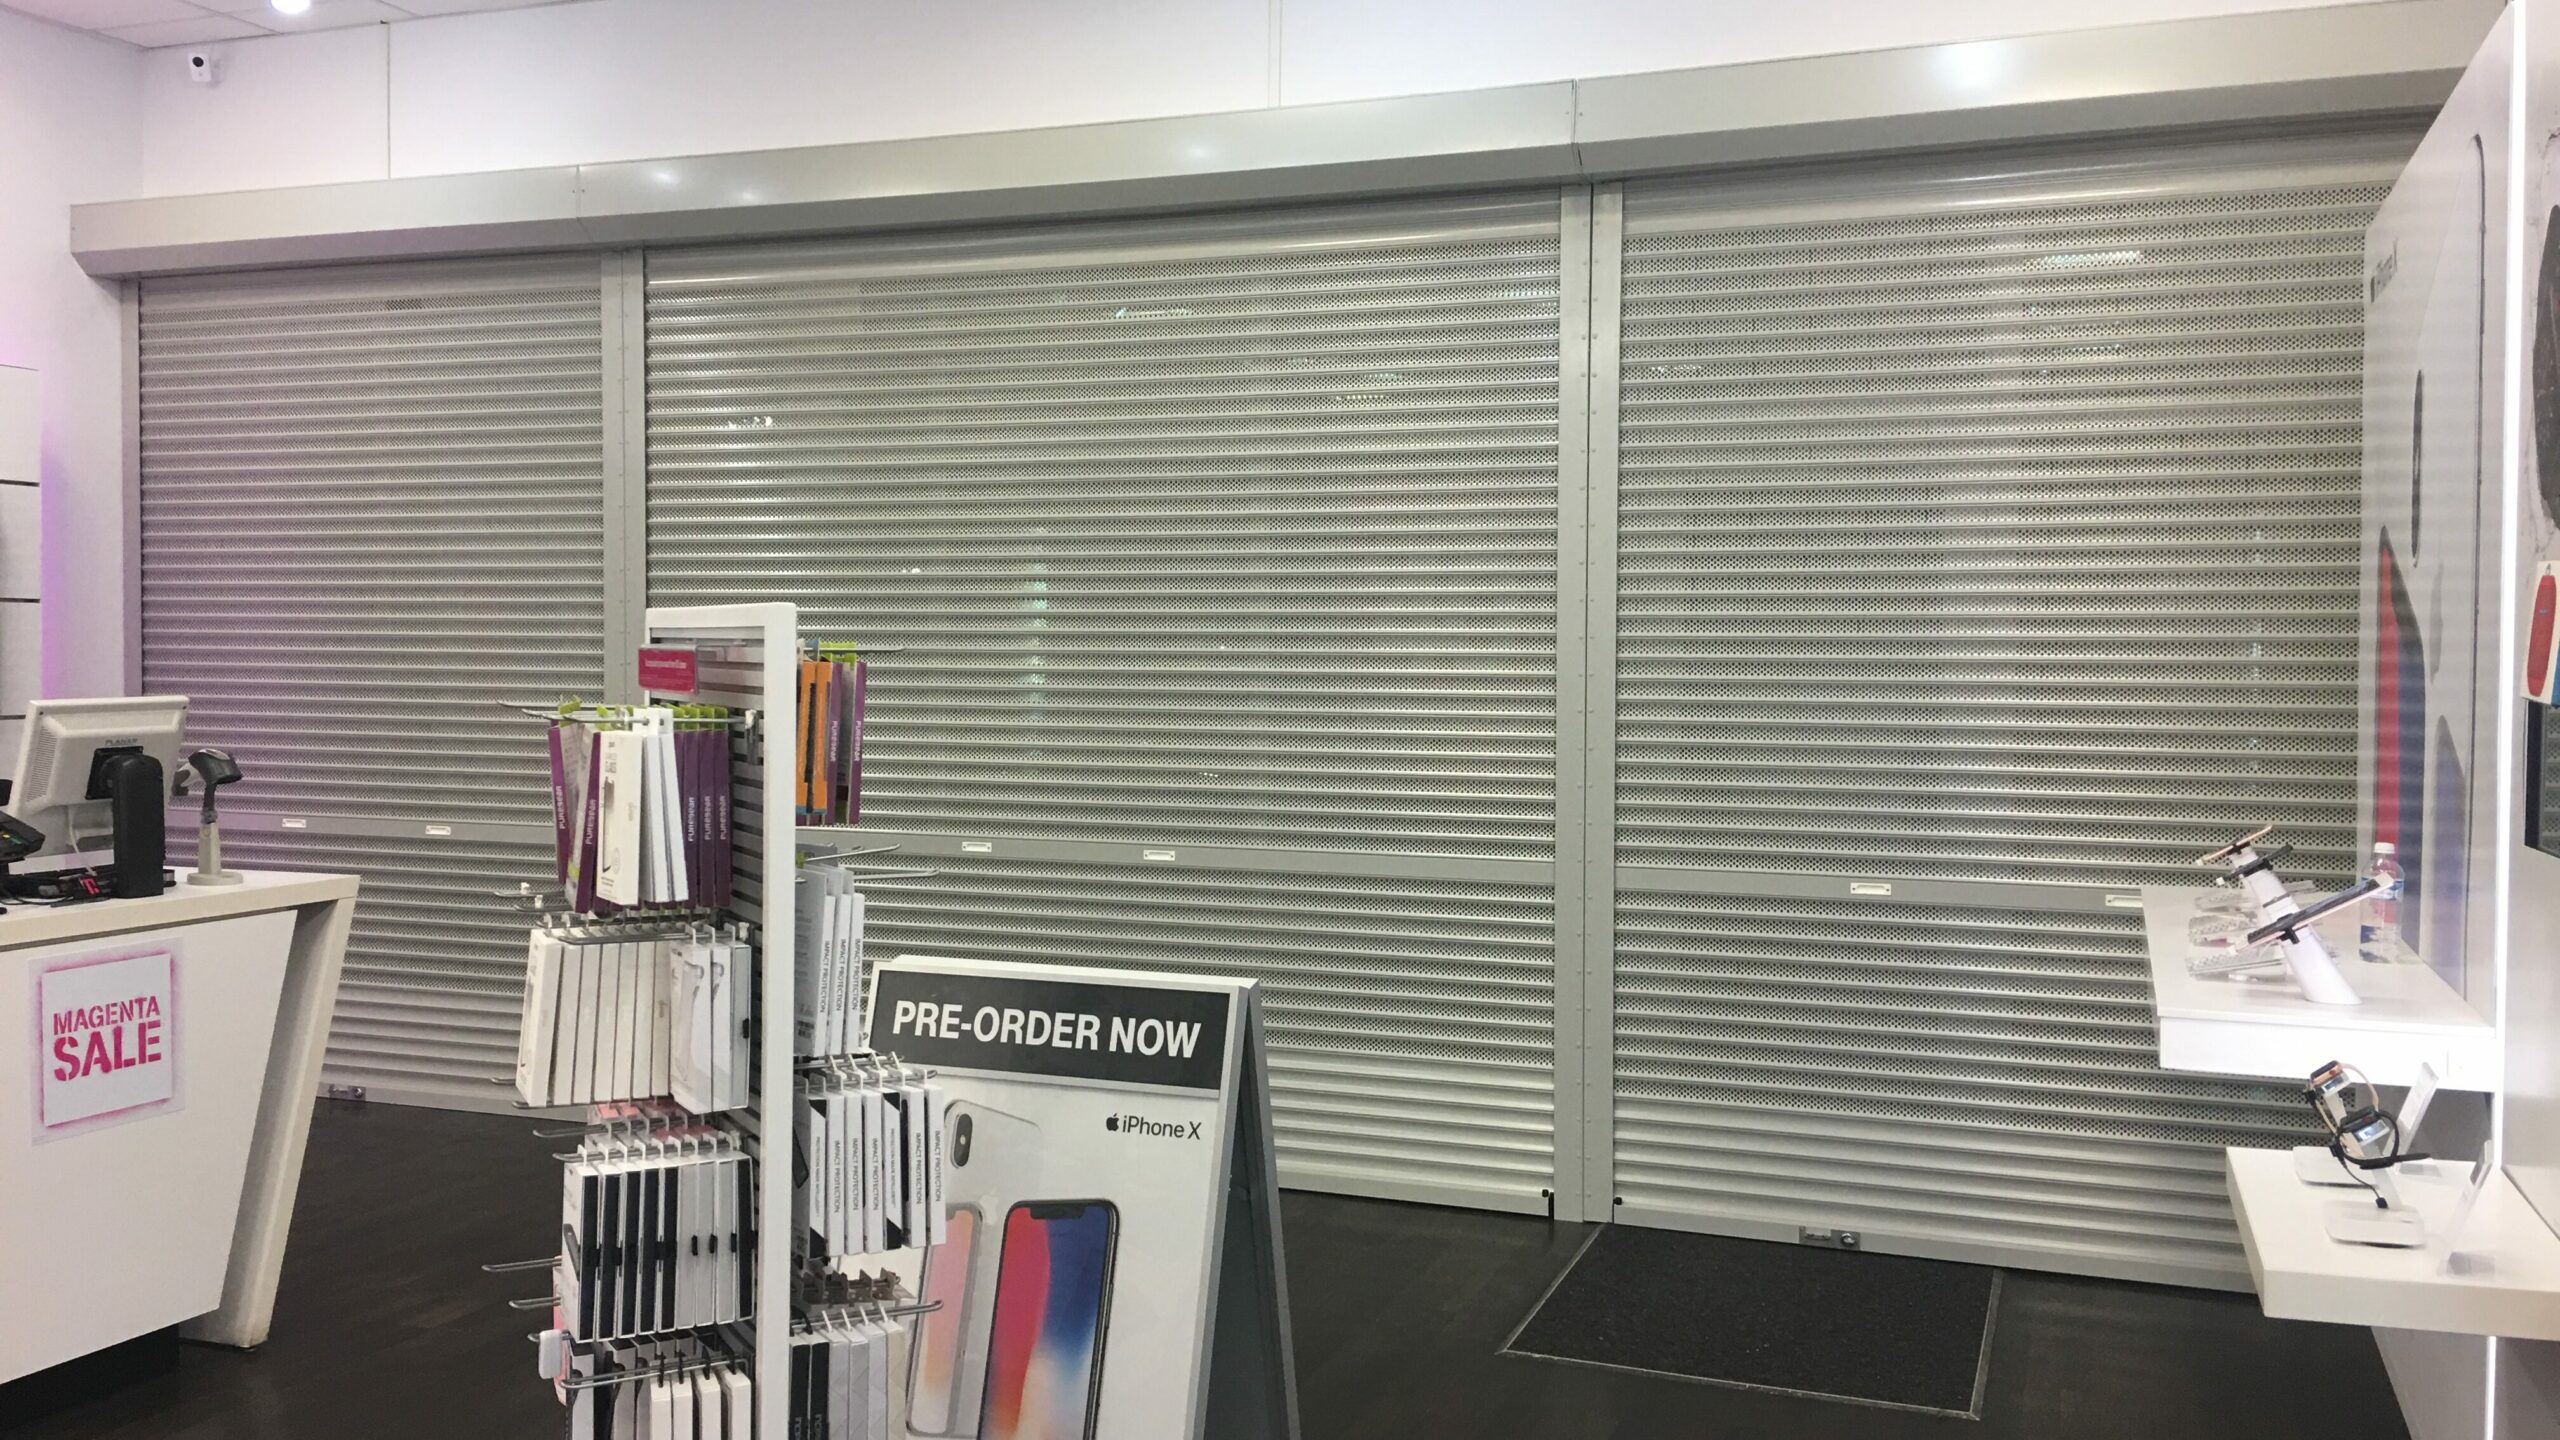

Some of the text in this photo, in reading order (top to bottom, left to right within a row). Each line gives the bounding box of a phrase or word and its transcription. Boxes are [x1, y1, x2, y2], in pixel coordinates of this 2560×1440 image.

[820, 968, 828, 1013] PROTECTION
[836, 966, 844, 1011] PROTECTION
[852, 966, 860, 1011] PROTECTION
[53, 995, 160, 1035] MAGENTA
[892, 1000, 1202, 1059] PRE-ORDER NOW
[53, 1020, 162, 1081] SALE
[1121, 1114, 1202, 1141] iPhone X
